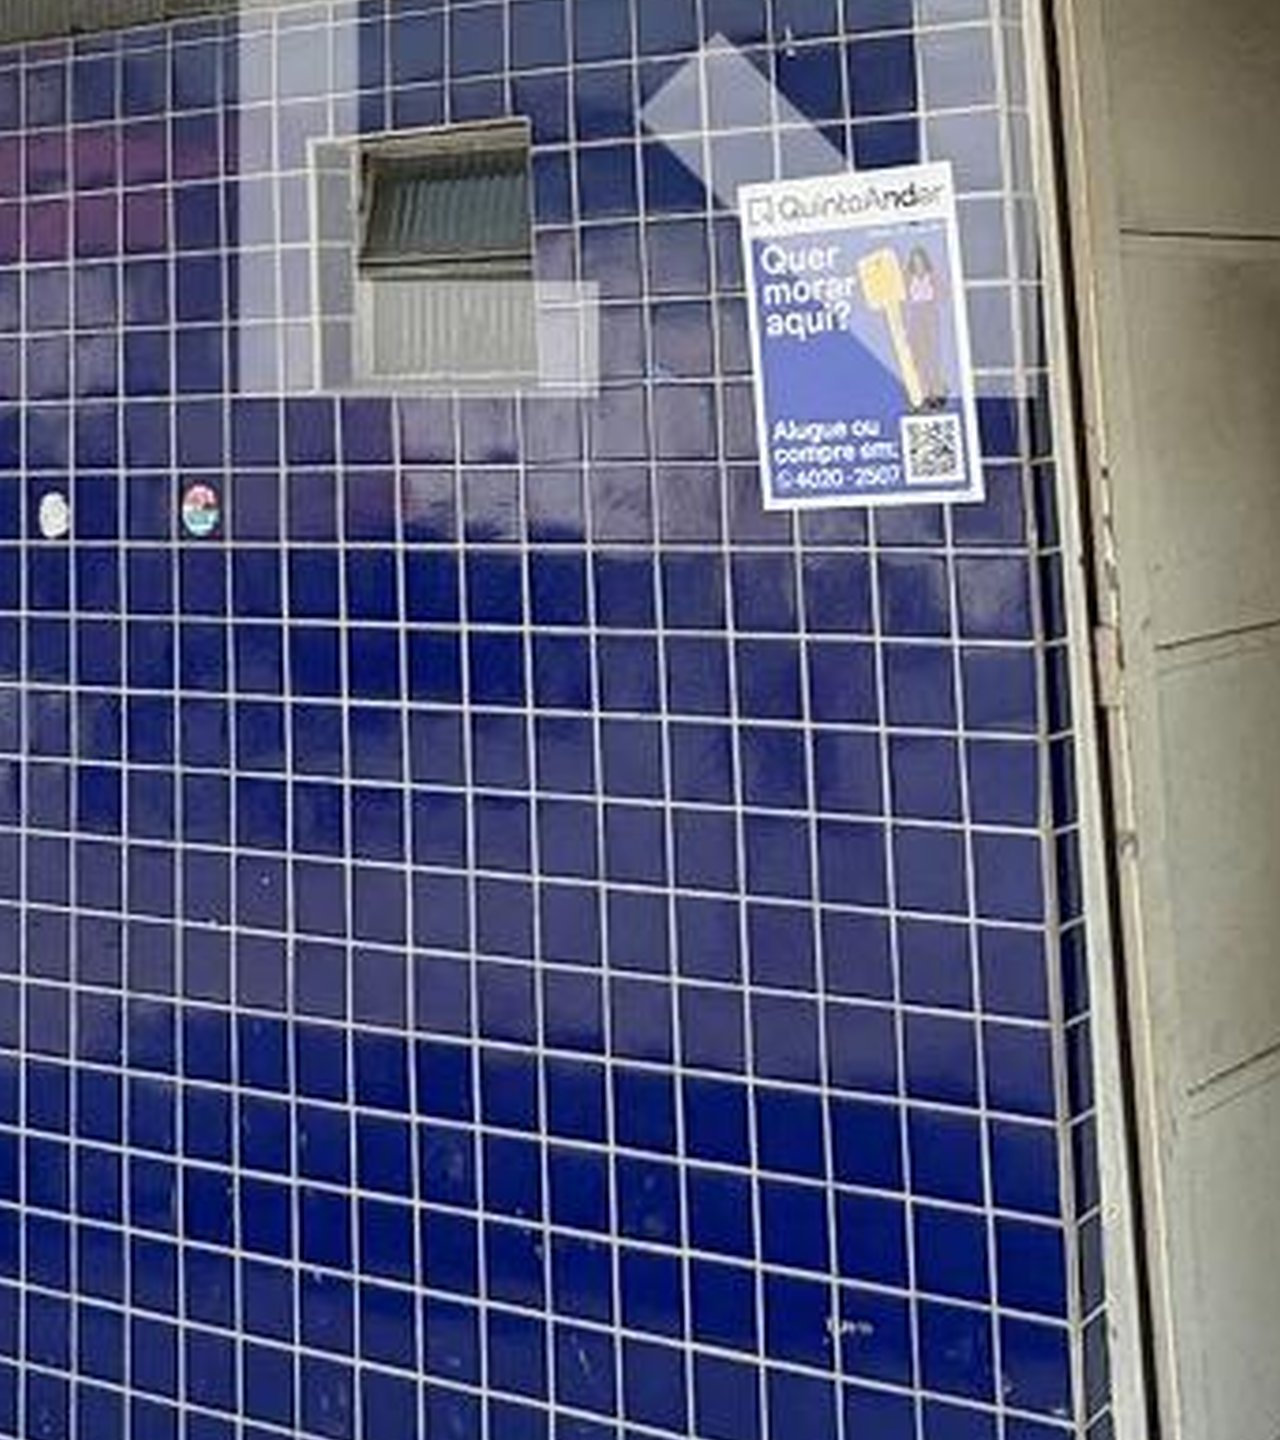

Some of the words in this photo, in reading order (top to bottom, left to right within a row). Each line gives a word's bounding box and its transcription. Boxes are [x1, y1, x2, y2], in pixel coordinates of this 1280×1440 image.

[777, 182, 944, 221] QuintoAndar
[760, 243, 840, 274] Quer
[763, 271, 855, 306] morar
[766, 303, 851, 341] aqui?
[773, 419, 847, 444] Alugue
[774, 445, 854, 466] compre
